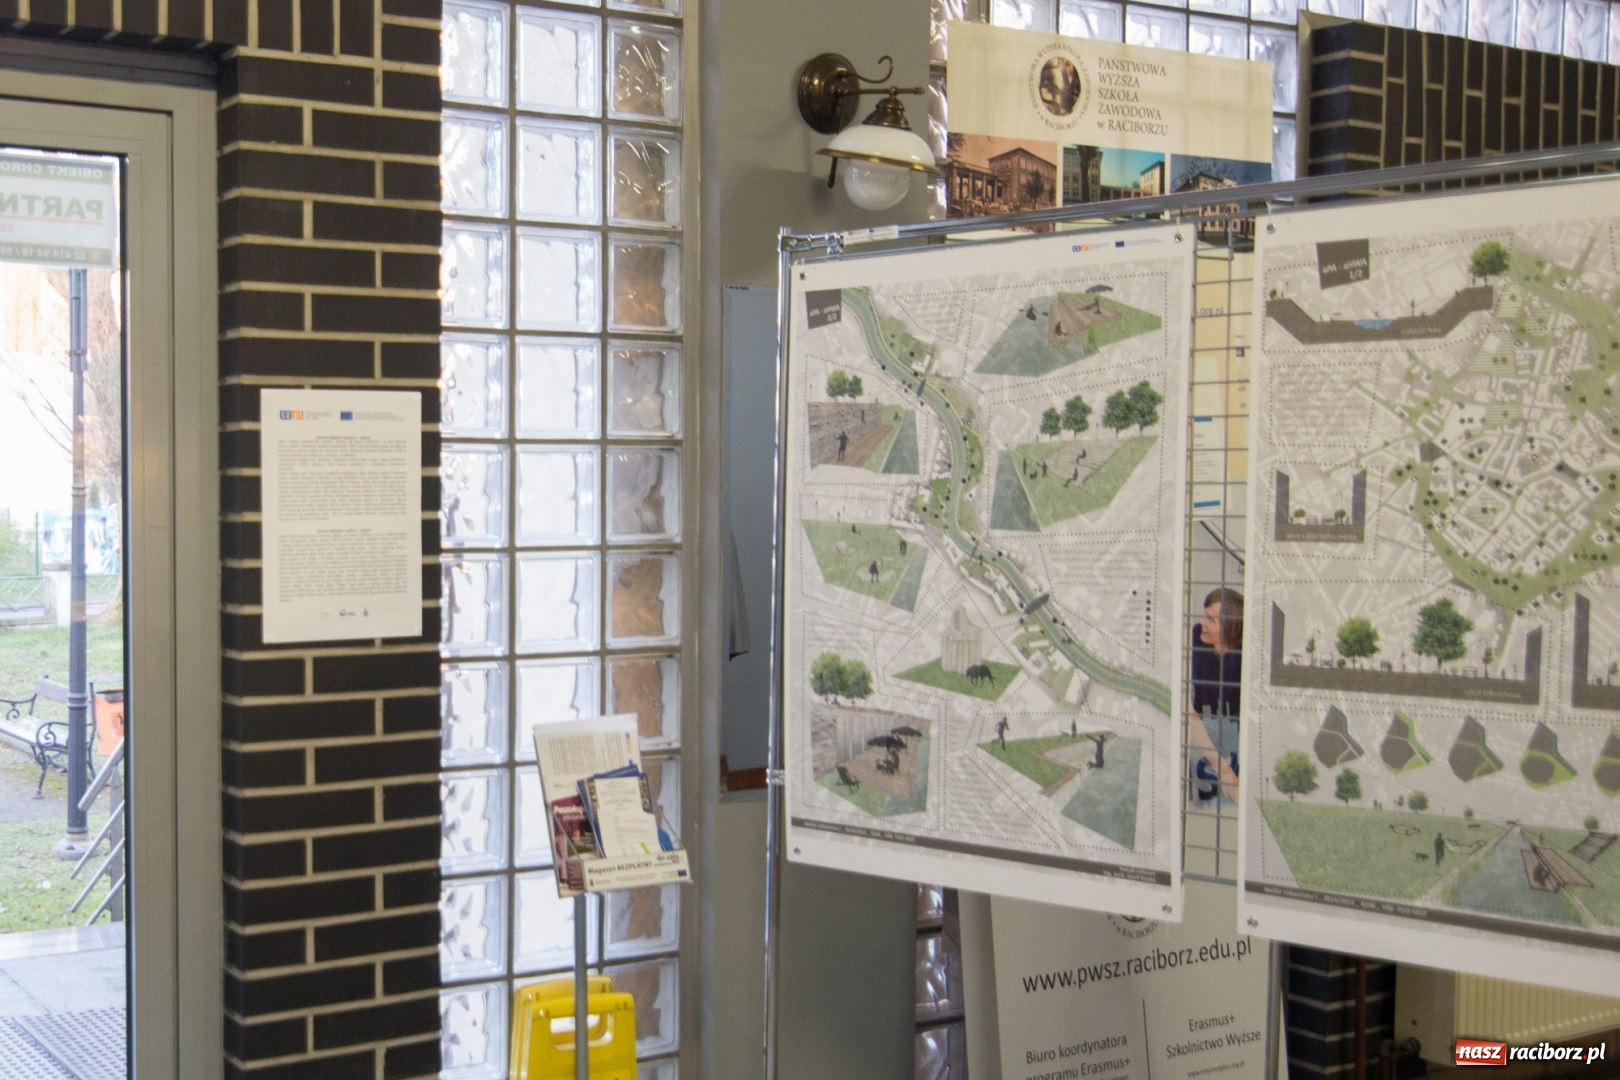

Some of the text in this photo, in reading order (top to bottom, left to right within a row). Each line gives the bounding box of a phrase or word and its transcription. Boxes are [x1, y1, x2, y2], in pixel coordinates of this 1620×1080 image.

[1098, 57, 1167, 77] PAŃSTWOWA
[1098, 72, 1141, 88] WYŻSZA
[1098, 87, 1139, 103] SZKOŁA
[1097, 103, 1162, 121] ZAWODOWA
[1097, 119, 1168, 136] w RACIBORZU
[588, 866, 617, 875] Magazyn
[1022, 934, 1252, 993] www.pwsz.raciborz.edu.pl
[1188, 1014, 1235, 1032] Erasmus+
[1025, 1035, 1128, 1065] Biuro koordynatora
[1166, 1030, 1261, 1059] Szkolnictwo Wyższe
[1080, 1056, 1131, 1076] Erasmus+
